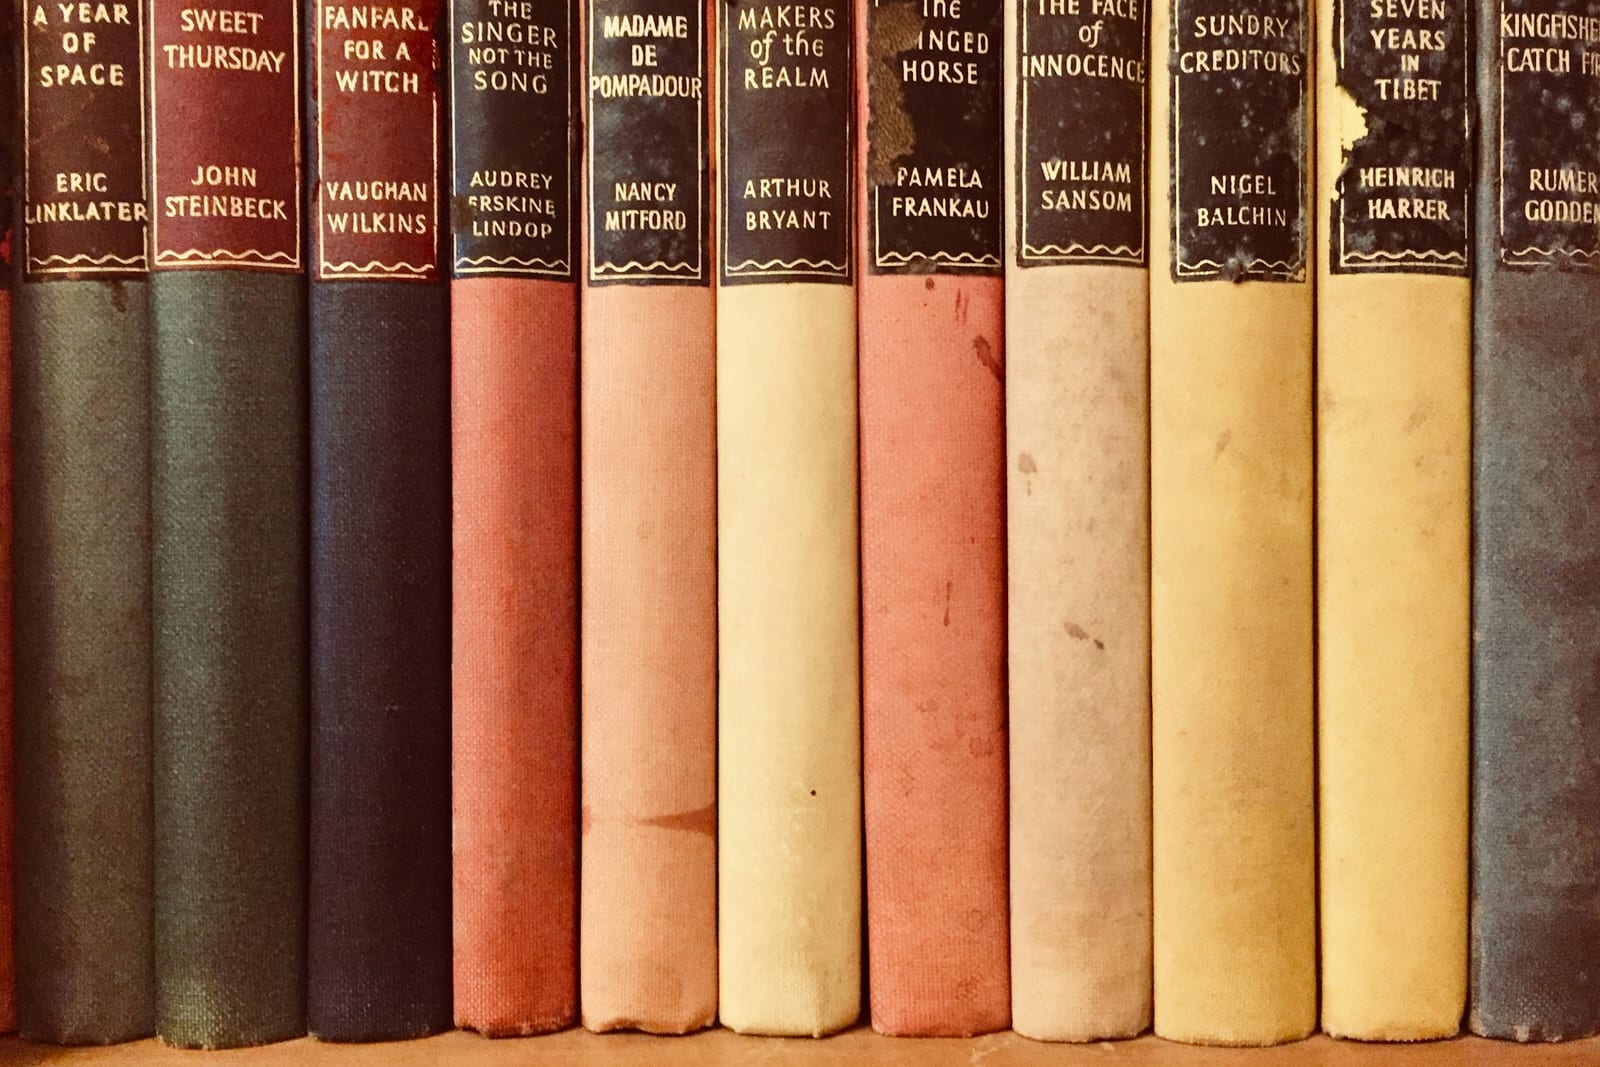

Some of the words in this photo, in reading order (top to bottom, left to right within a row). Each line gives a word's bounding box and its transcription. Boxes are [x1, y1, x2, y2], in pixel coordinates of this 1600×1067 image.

[33, 6, 48, 25] A
[59, 3, 131, 24] YEAR
[489, 0, 532, 19] THE
[738, 5, 835, 30] MAKERS
[1039, 0, 1080, 15] THE
[1092, 0, 1137, 20] FACE
[1370, 0, 1446, 19] SEVEN
[181, 9, 263, 34] SWEET
[604, 15, 687, 38] MADAME
[1194, 15, 1288, 38] SUNDRY
[1501, 13, 1600, 42] KINGFISHE
[63, 32, 96, 53] OF
[462, 22, 557, 48] SINGER
[918, 29, 989, 54] INGED
[1079, 20, 1104, 48] of
[1370, 29, 1446, 50] YEARS
[344, 40, 386, 60] FOR
[396, 42, 411, 61] A
[469, 48, 509, 64] NOT
[514, 50, 552, 69] THE
[631, 45, 657, 66] DE
[750, 30, 776, 65] of
[783, 31, 824, 57] the
[163, 45, 285, 73] THURSDAY
[1022, 54, 1145, 83] INNOCENCE
[1180, 50, 1300, 76] CREDITORS
[1401, 55, 1419, 72] IN
[1508, 48, 1570, 73] CATCH
[40, 64, 124, 87] SPACE
[336, 71, 418, 93] WITCH
[474, 71, 547, 94] SONG
[744, 67, 829, 89] REALM
[902, 60, 978, 84] HORSE
[591, 75, 702, 98] POMPADOUR
[1375, 79, 1441, 101] TIBET
[56, 173, 108, 192] ERIC
[191, 166, 256, 187] JOHN
[470, 171, 552, 190] AUDREY
[897, 167, 982, 188] PAMELA
[1041, 161, 1131, 183] WILLIAM
[1360, 167, 1455, 189] HEINRICH
[1530, 169, 1598, 193] RUMER
[327, 181, 427, 202] VAUGHAN
[615, 183, 676, 201] NANCY
[743, 178, 831, 198] ARTHUR
[1211, 174, 1276, 195] NIGEL
[166, 196, 287, 220] STEINBECK
[892, 197, 989, 218] FRANKAU
[1041, 190, 1131, 212] SANSOM
[1368, 198, 1450, 221] HARRER
[25, 202, 148, 224] LINKLATER
[327, 212, 426, 234] WILKINS
[605, 210, 686, 231] MITFORD
[746, 211, 831, 230] BRYANT
[1198, 207, 1287, 227] BALCHIN
[472, 221, 552, 239] LINDOP
